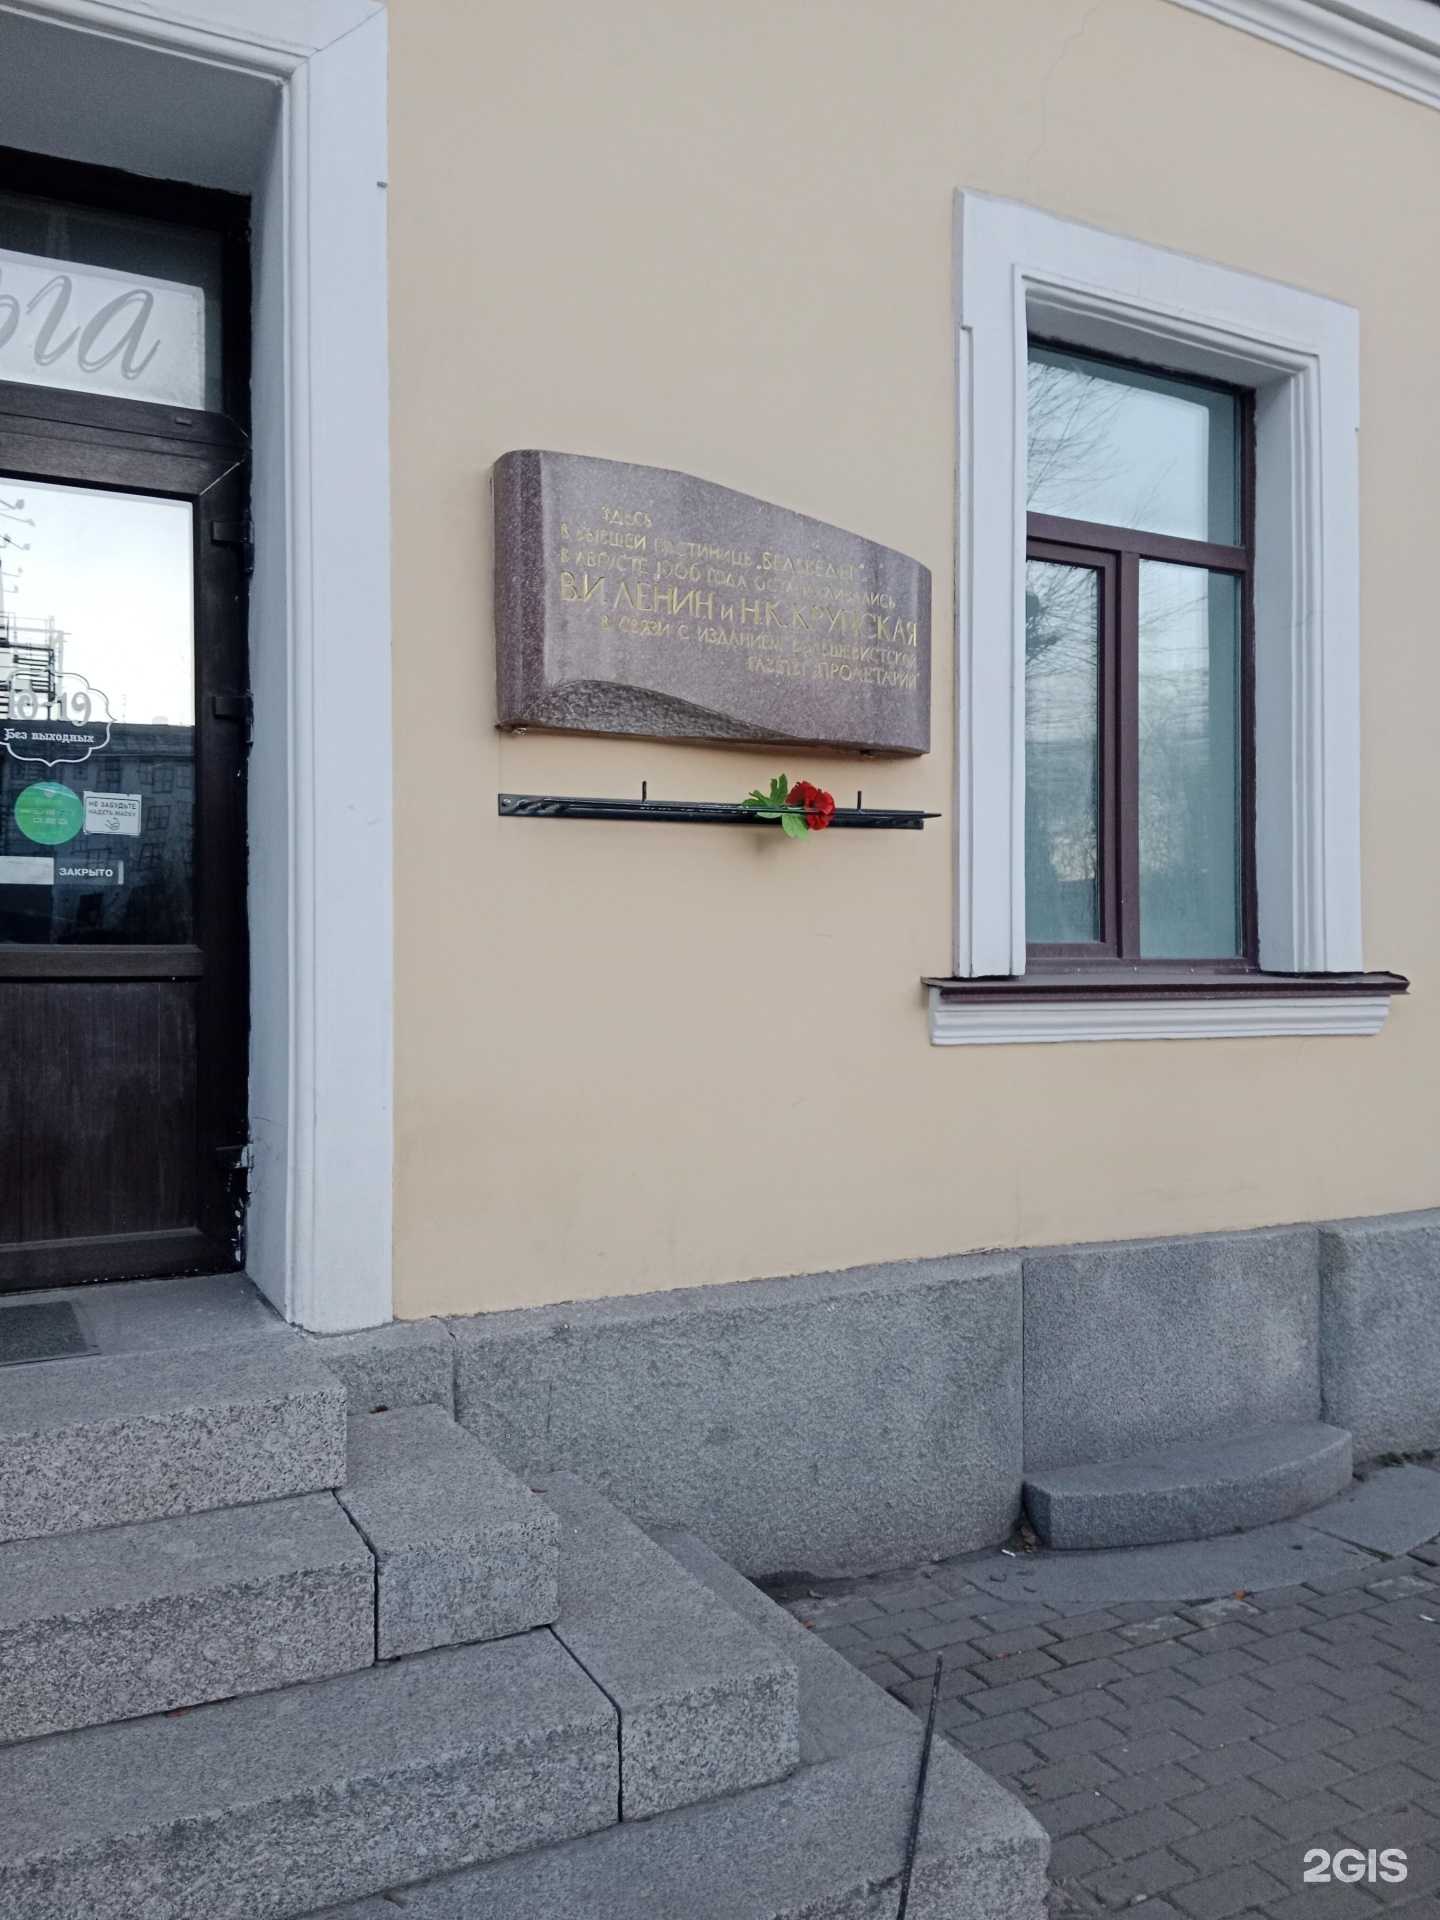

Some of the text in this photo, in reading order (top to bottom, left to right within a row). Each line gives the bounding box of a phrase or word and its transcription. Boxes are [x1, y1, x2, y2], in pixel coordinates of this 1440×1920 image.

[602, 506, 652, 528] ЗДЕСЬ
[560, 523, 570, 540] В
[560, 546, 570, 564] В
[576, 550, 648, 575] АВГУСТЕ
[707, 566, 747, 590] ГОДА
[614, 582, 716, 622] ЛЕНИН
[792, 604, 918, 647] КРУПСКАЯ
[618, 615, 671, 637] СВЯЗИ
[4, 727, 96, 744] Без выходных
[101, 801, 137, 810] ЗАБУДЬТЕ
[58, 867, 114, 878] ЗАКРЫТО
